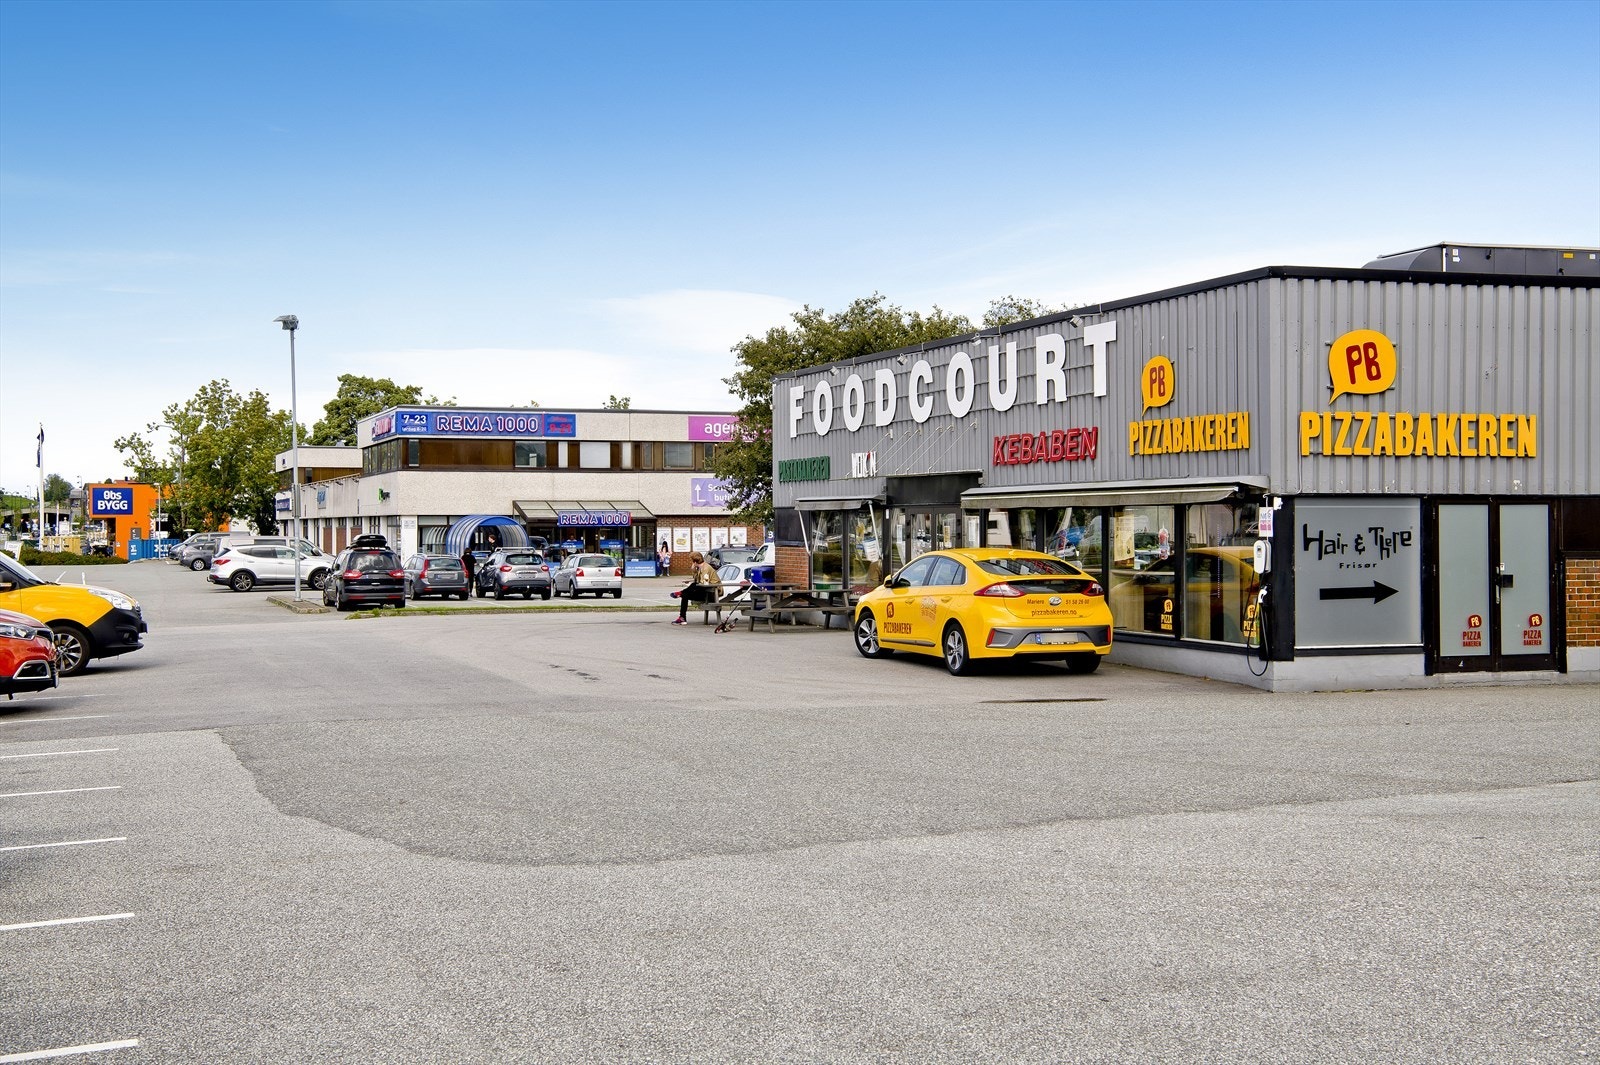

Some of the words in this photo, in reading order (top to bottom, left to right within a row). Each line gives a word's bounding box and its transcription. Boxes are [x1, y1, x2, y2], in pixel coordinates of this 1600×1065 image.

[1346, 341, 1382, 385] PB
[789, 320, 1117, 438] FOODCOURT
[1149, 365, 1166, 397] PB
[403, 415, 427, 424] 7-23
[436, 415, 493, 432] REMA
[497, 416, 539, 433] 1000
[993, 426, 1098, 466] KEBABEN
[1129, 411, 1250, 456] PIZZABAKEREN
[1300, 411, 1537, 457] PIZZABAKEREN
[97, 500, 128, 510] BYGG
[561, 513, 598, 525] REMA
[601, 513, 629, 525] 1000
[1303, 523, 1348, 560] Hair
[1355, 534, 1366, 555] &
[1031, 609, 1077, 617] pizzabakeren.no
[1463, 631, 1481, 640] PIZZA
[1524, 630, 1542, 639] PIZZA
